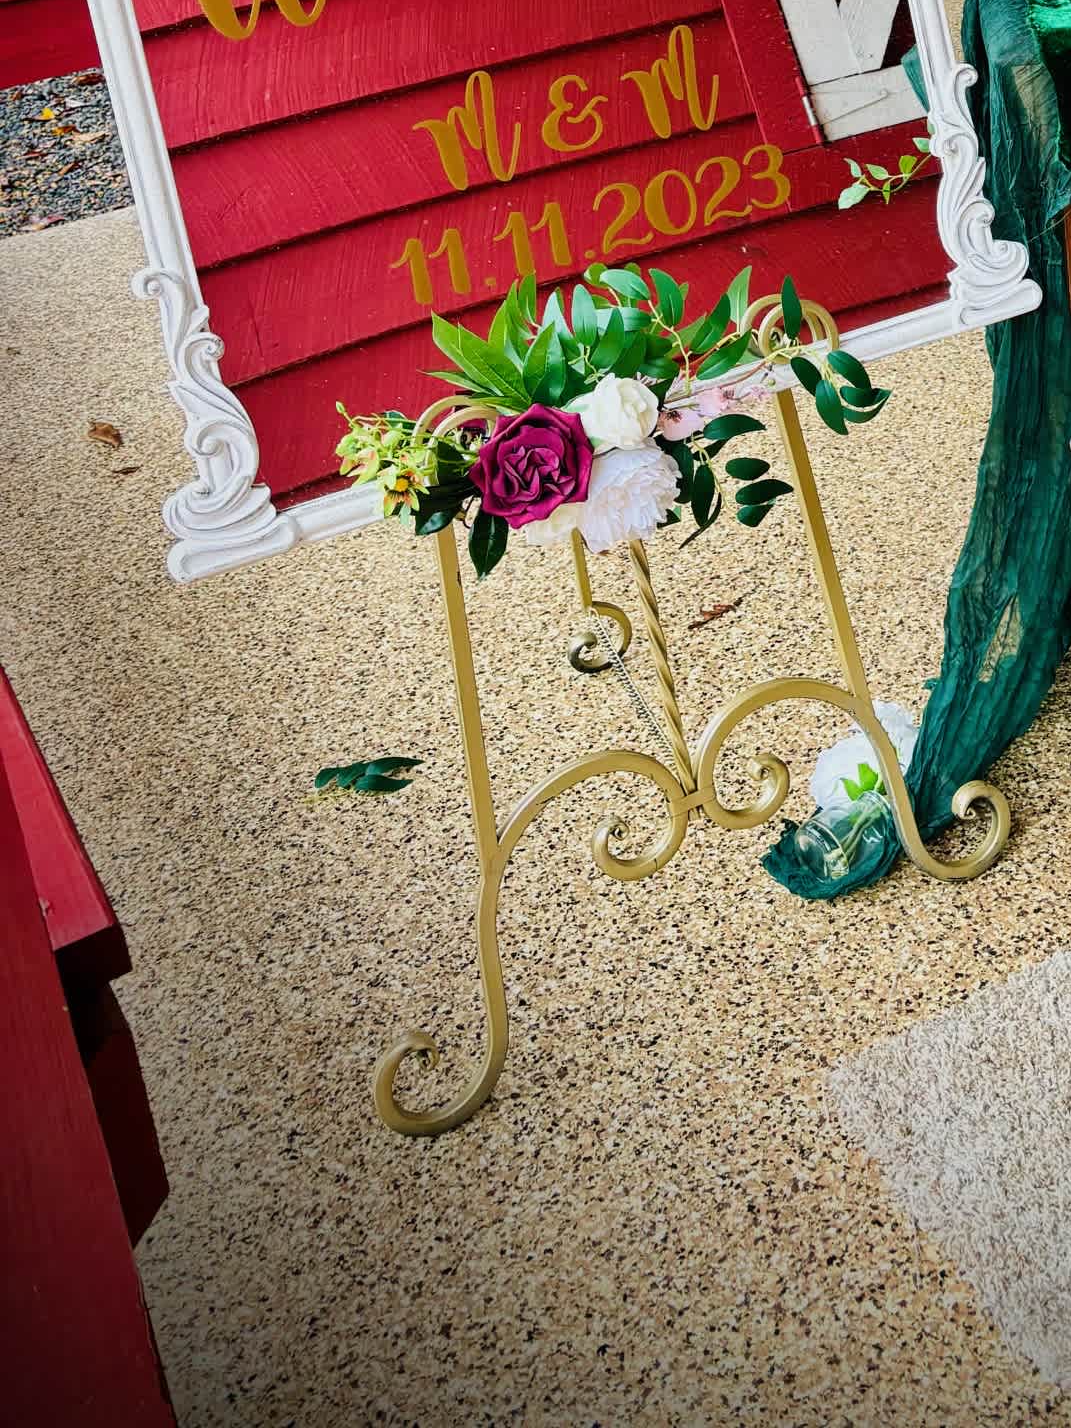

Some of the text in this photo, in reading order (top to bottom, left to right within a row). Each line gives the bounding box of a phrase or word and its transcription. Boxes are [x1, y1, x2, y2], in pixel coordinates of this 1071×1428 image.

[412, 24, 720, 191] M & M
[391, 144, 792, 306] 11.11.2023
